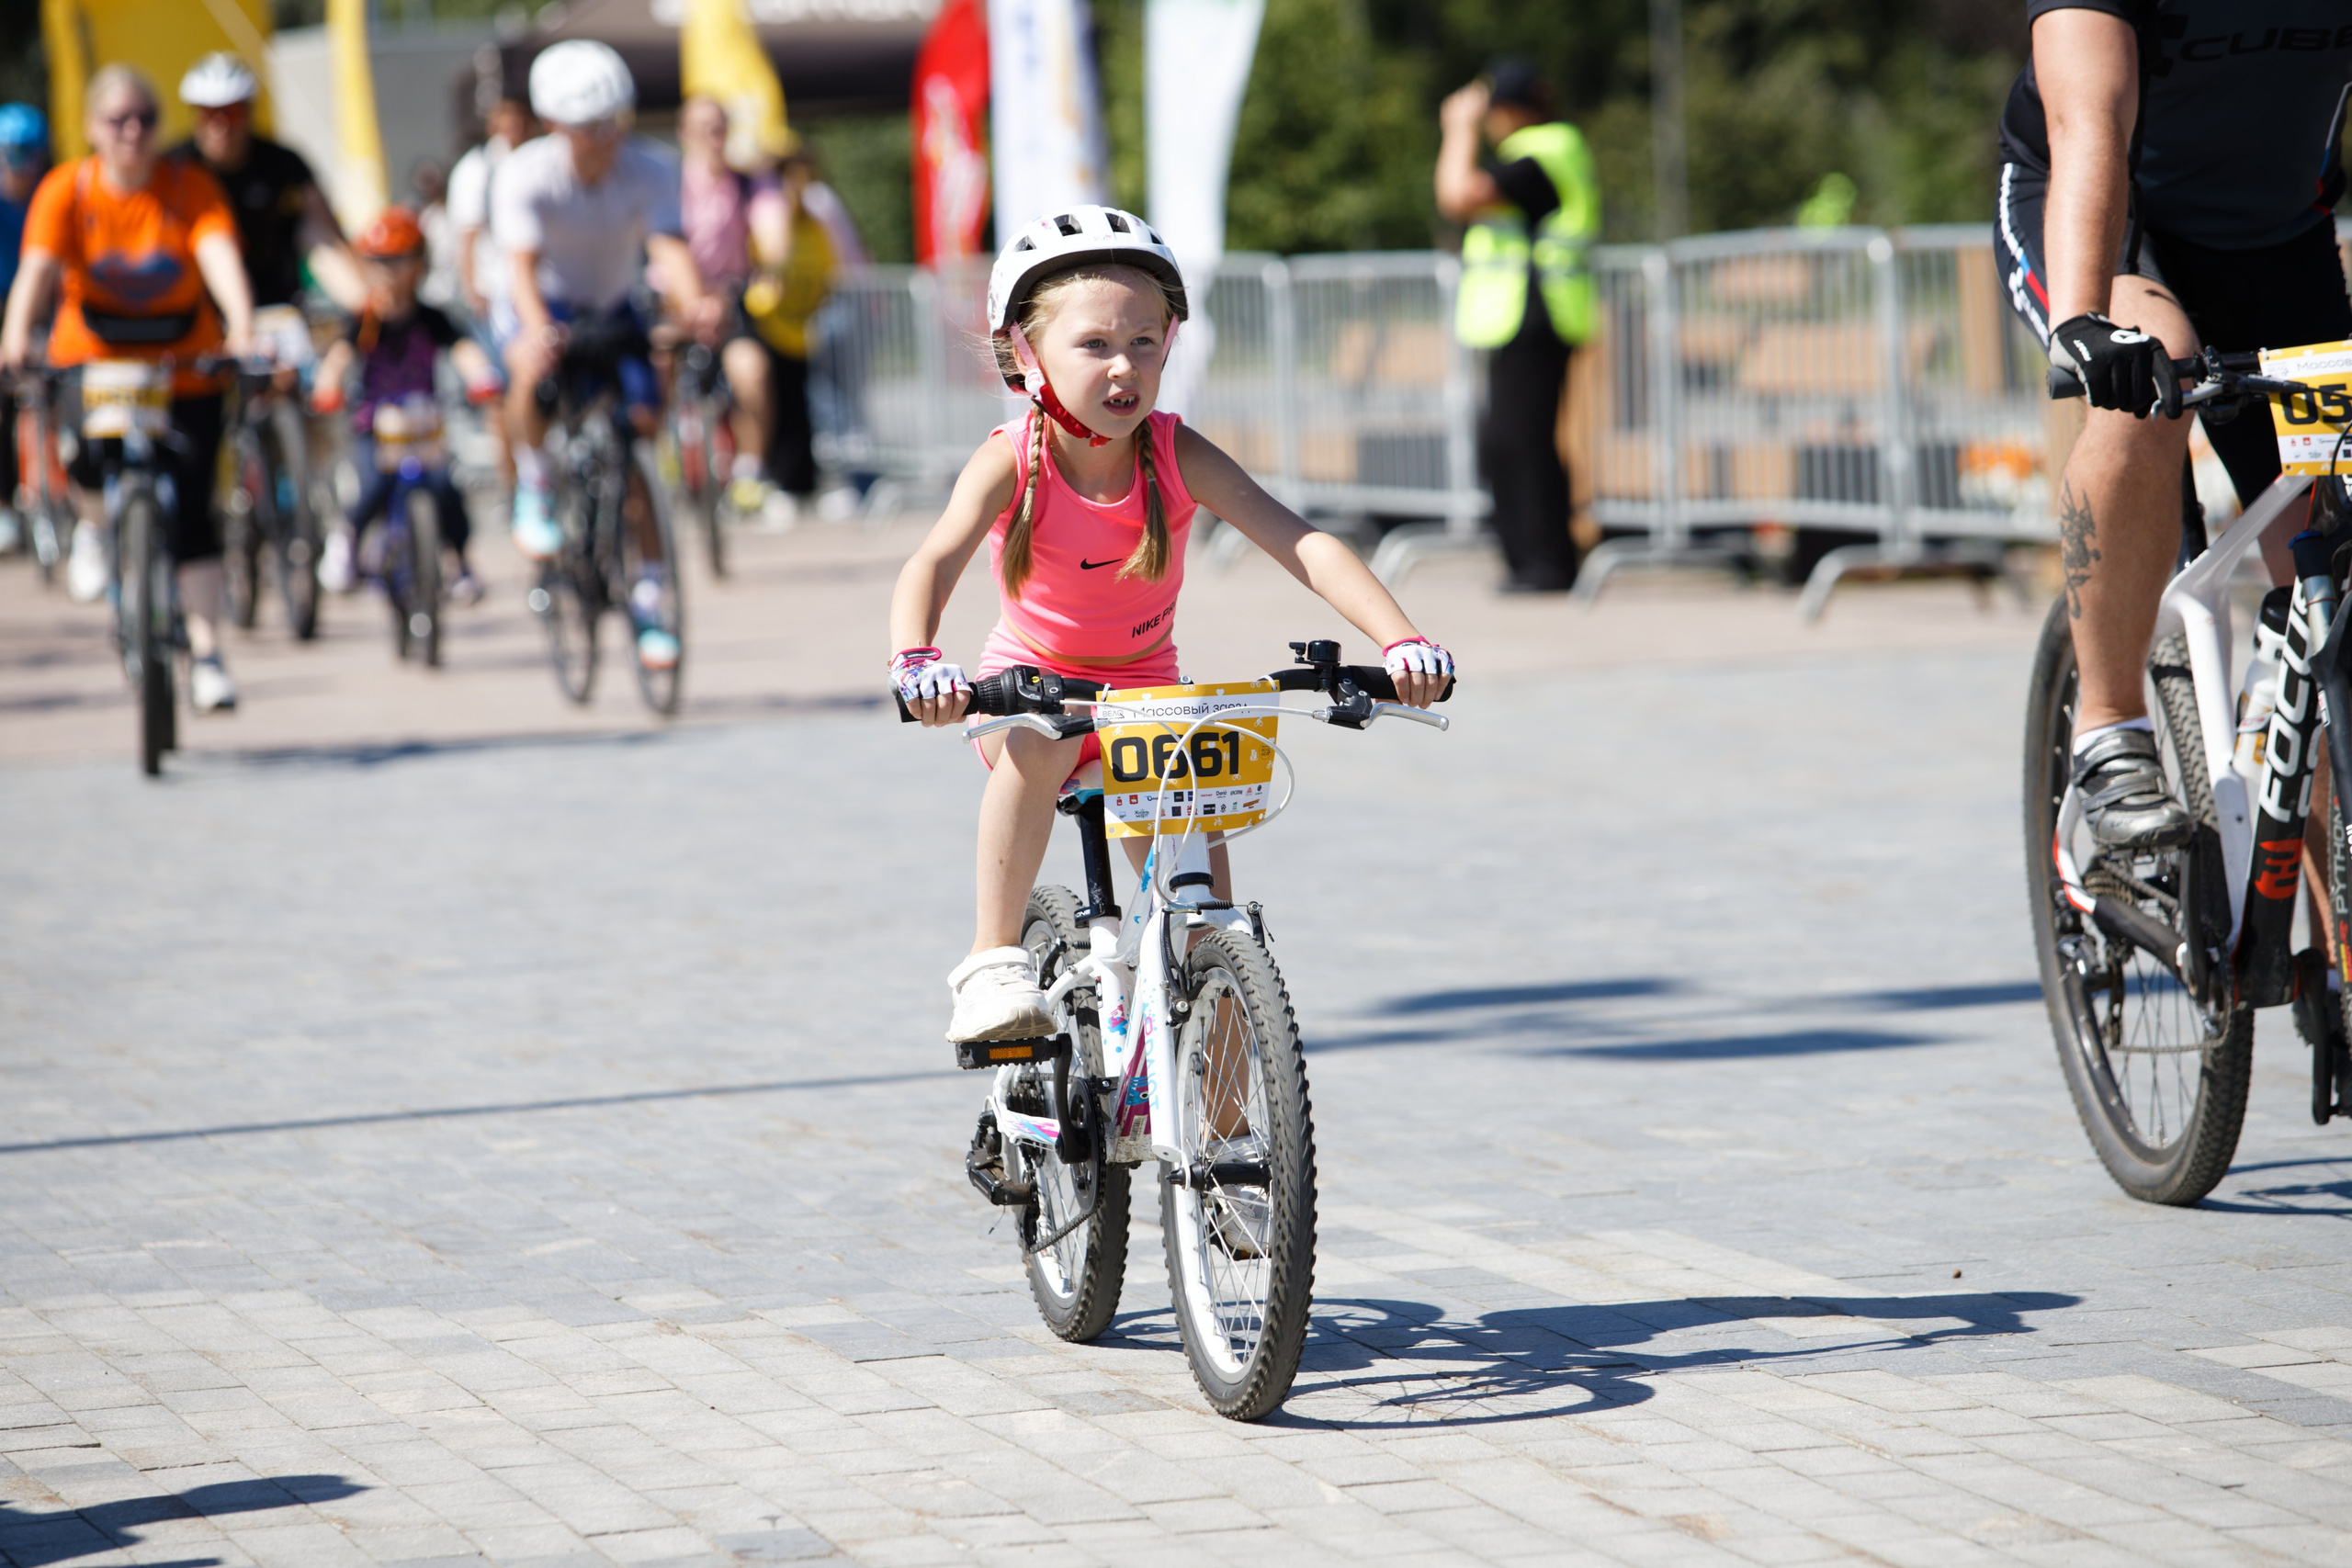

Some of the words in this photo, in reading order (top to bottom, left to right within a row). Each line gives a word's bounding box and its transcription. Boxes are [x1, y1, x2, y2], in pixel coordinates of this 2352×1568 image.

[2280, 384, 2352, 425] 05
[1132, 614, 1160, 637] NIKE
[1111, 731, 1239, 783] 0661
